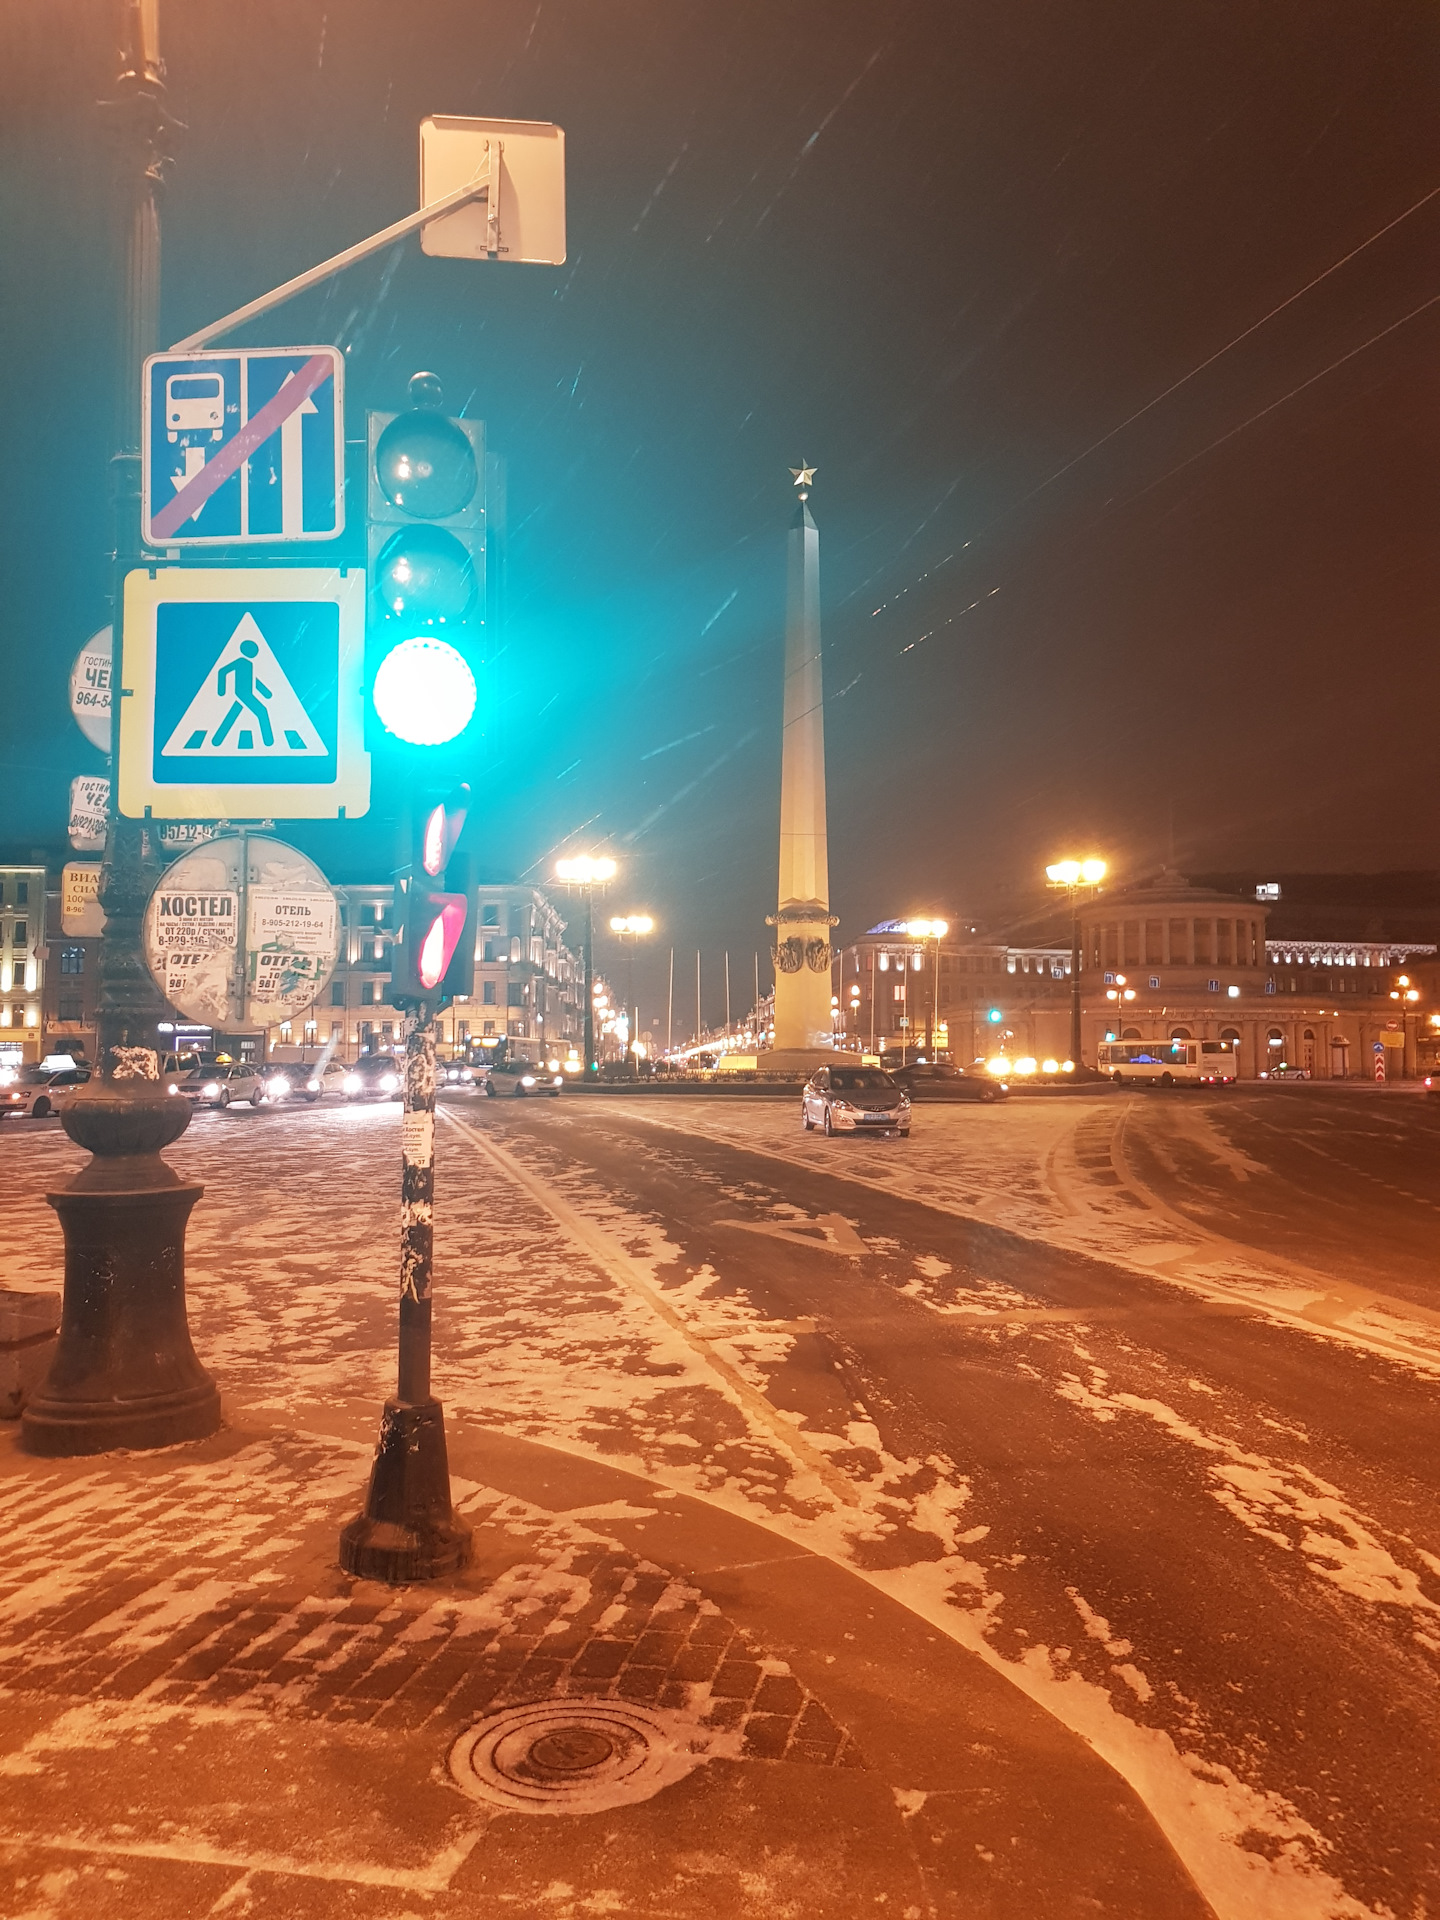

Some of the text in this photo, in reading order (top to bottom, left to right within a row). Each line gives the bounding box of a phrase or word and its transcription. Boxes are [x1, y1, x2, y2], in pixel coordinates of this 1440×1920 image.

[86, 668, 112, 689] ЧЕ
[66, 905, 85, 913] 8-96
[160, 896, 232, 917] ХОСТЕЛ
[275, 905, 311, 916] ОТЕЛЬ
[261, 919, 323, 929] 8-905-212-19-64
[165, 927, 175, 936] ОТ
